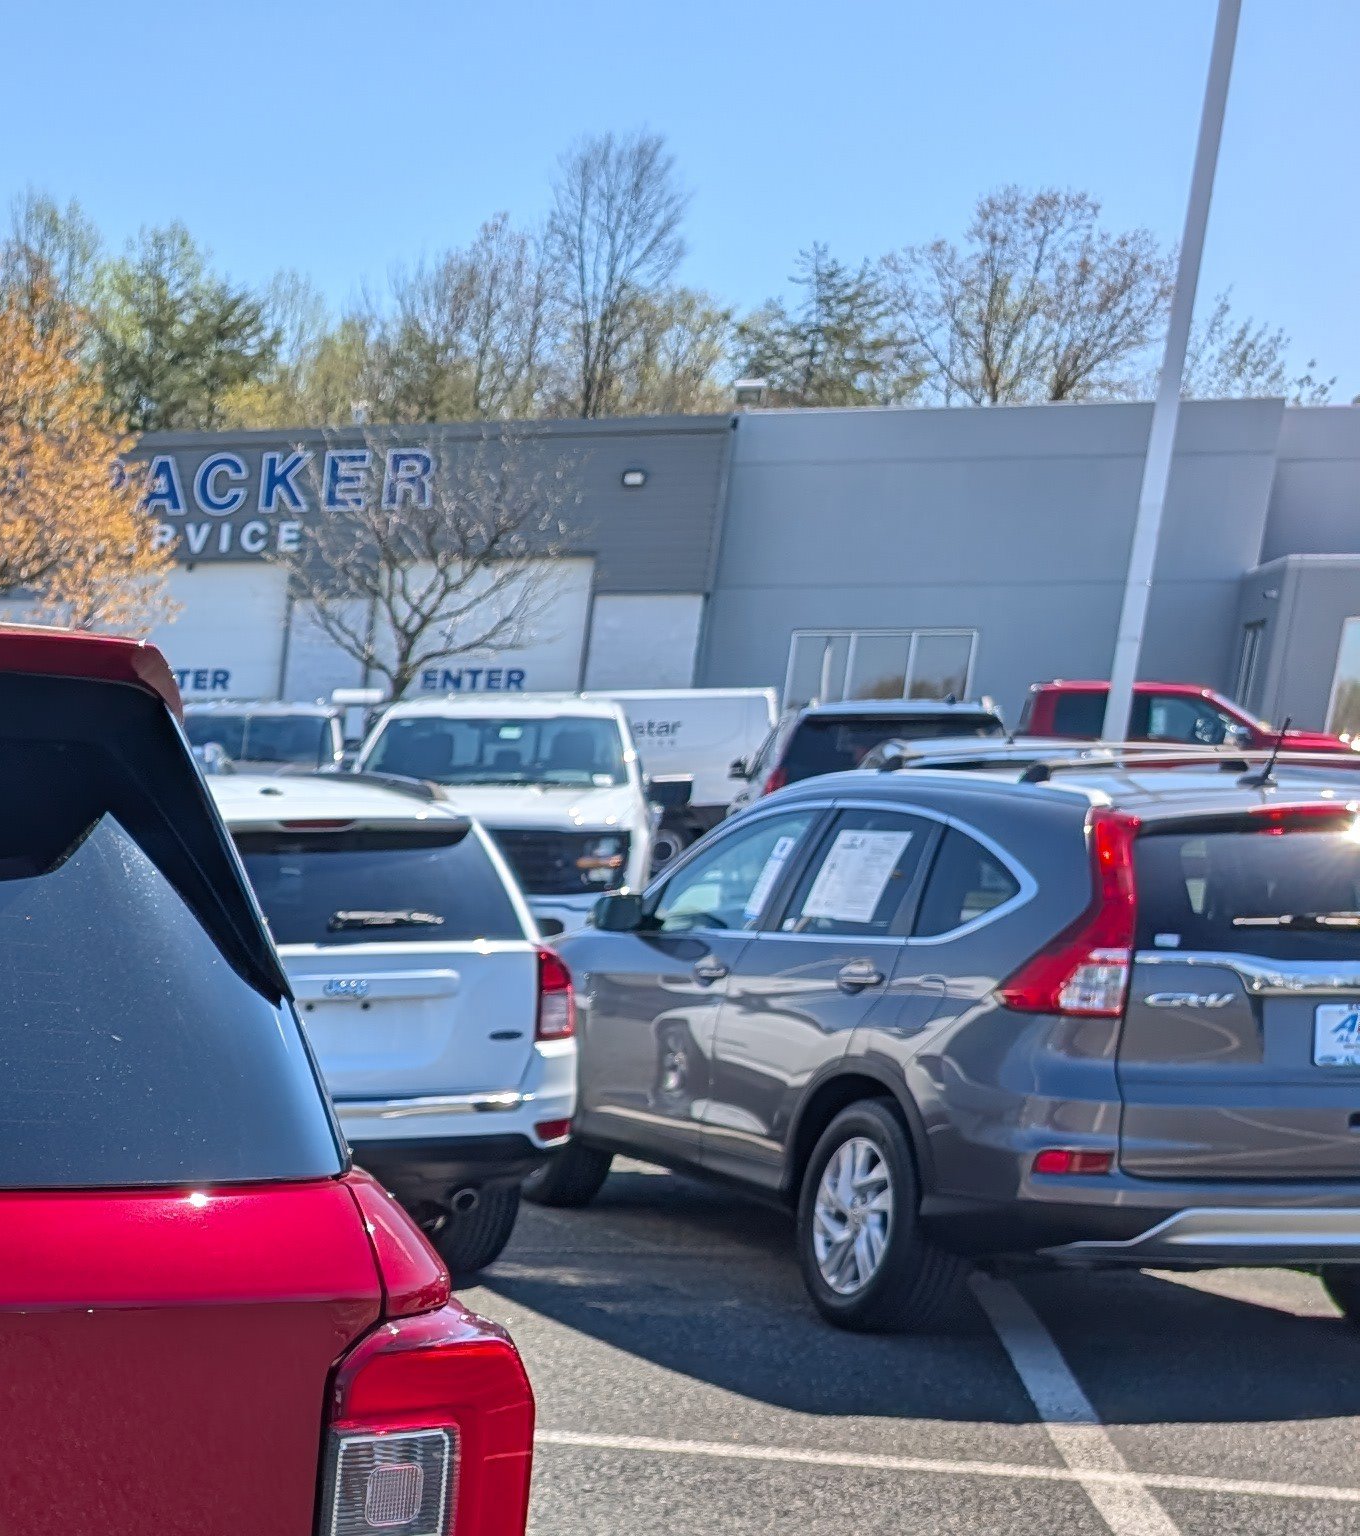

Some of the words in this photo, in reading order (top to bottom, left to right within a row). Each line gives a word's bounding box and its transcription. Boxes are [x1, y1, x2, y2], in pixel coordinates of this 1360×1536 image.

[112, 448, 437, 516] ACKER
[150, 520, 302, 554] RVICE
[175, 668, 231, 691] TER
[420, 667, 526, 691] ENTER
